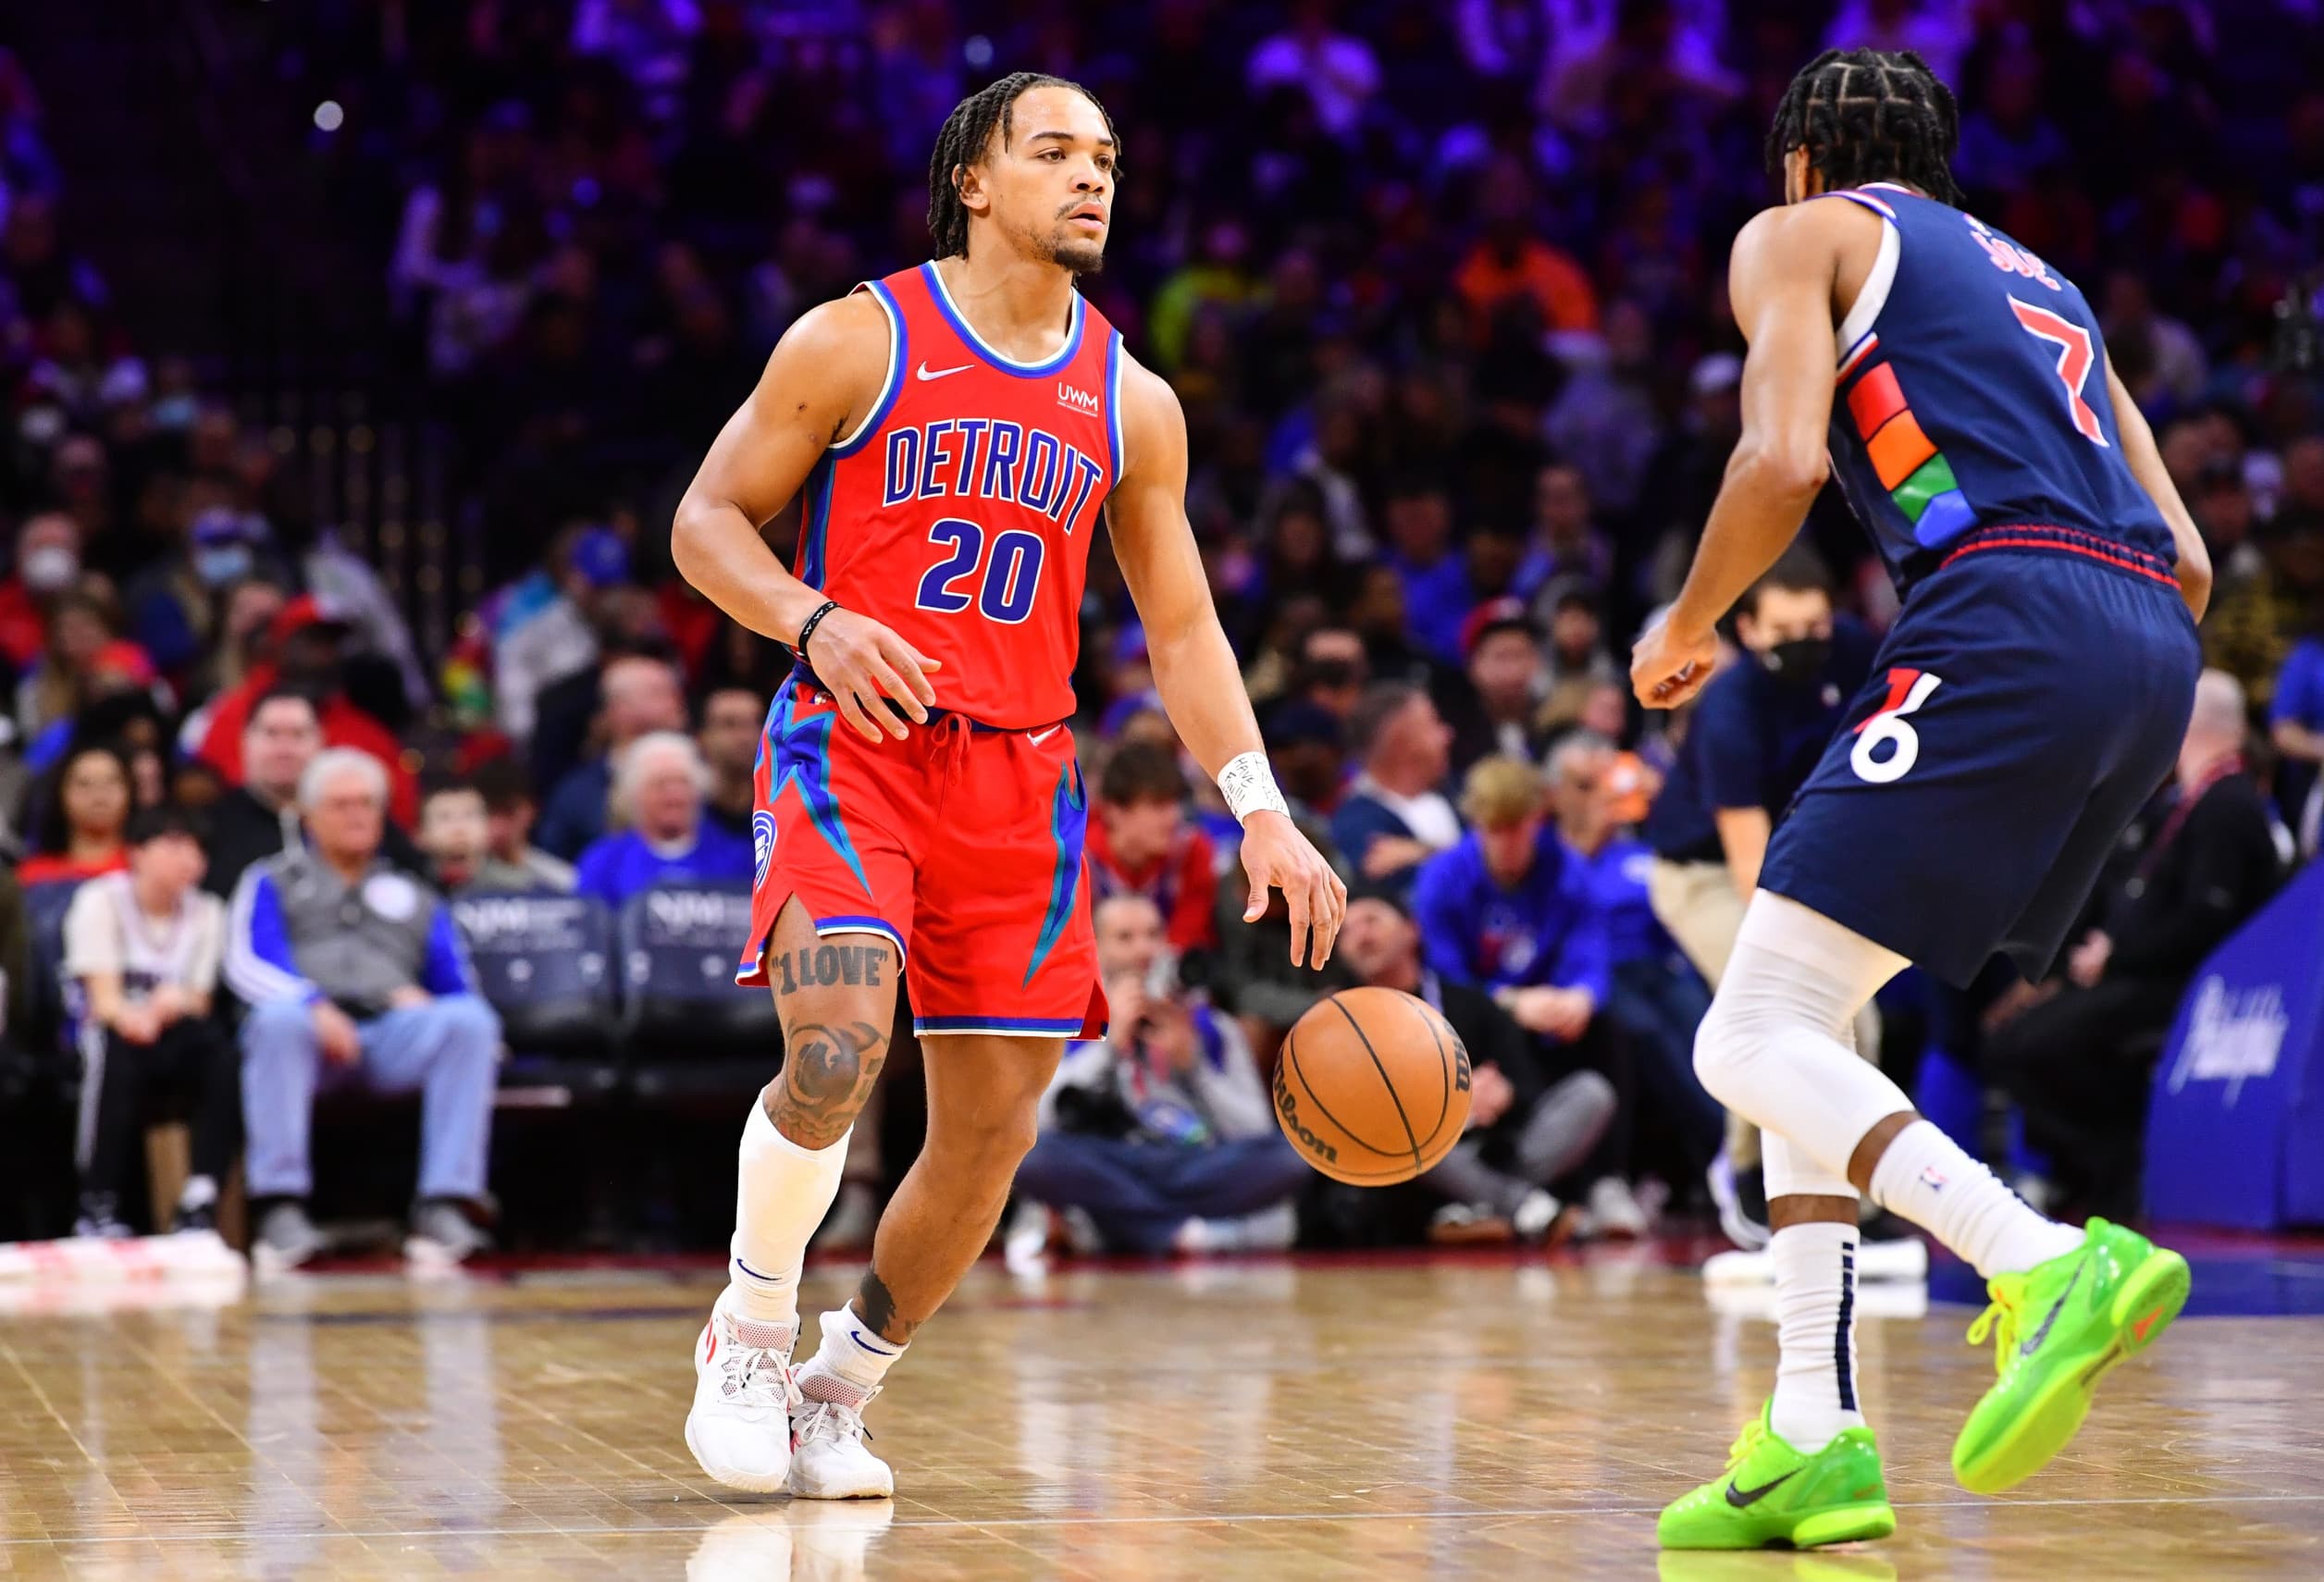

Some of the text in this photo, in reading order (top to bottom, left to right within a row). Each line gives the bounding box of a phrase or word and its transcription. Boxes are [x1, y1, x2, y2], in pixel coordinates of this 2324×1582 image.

[1057, 381, 1099, 412] UWM
[2006, 291, 2110, 448] 7
[882, 418, 1104, 538] DETROIT
[914, 517, 1045, 625] 20
